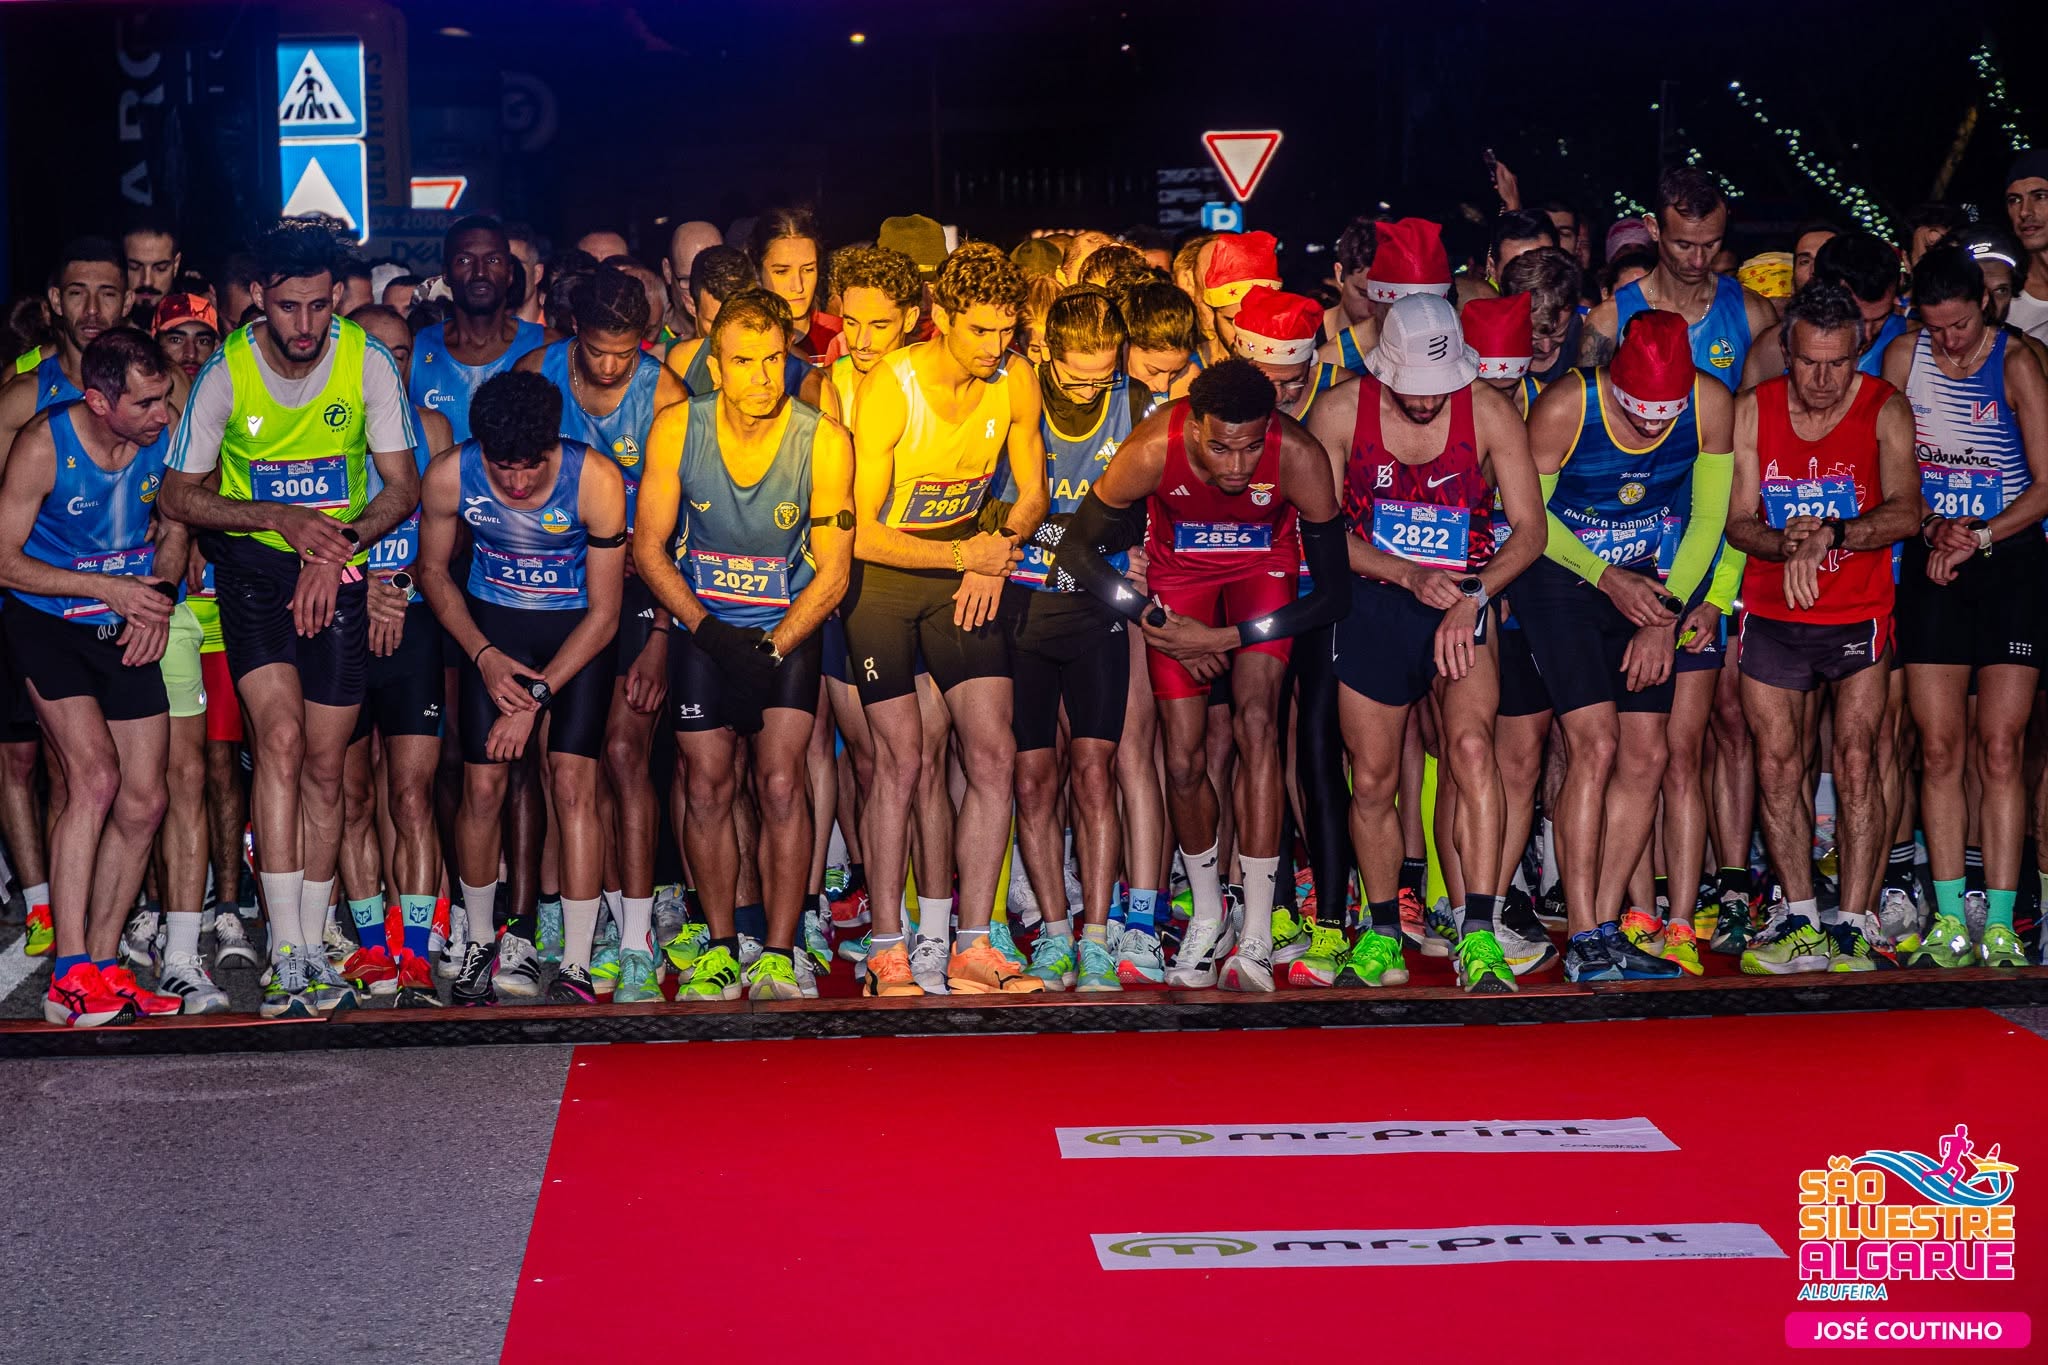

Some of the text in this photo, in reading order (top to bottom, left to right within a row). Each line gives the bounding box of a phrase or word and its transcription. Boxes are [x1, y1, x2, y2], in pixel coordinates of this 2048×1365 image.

[1211, 207, 1238, 231] P
[1917, 444, 1999, 468] Odemira
[256, 464, 281, 472] DELL
[1924, 471, 1943, 480] DELL
[270, 476, 329, 498] 3006
[919, 484, 942, 492] DELL
[1768, 485, 1791, 493] DELL
[76, 500, 100, 509] TRAVEL
[920, 495, 971, 517] 2981
[1381, 503, 1406, 513] DELL
[1784, 501, 1840, 520] 2826
[1933, 492, 1985, 516] 2816
[473, 514, 501, 524] TRAVEL
[1194, 532, 1252, 544] 2856
[1392, 523, 1450, 550] 2822
[1582, 530, 1607, 542] DELL
[367, 538, 409, 562] 170
[487, 551, 511, 561] DELL
[698, 553, 721, 563] DELL
[1599, 539, 1647, 565] 2928
[77, 560, 98, 570] DELL
[501, 566, 558, 584] 2160
[712, 569, 769, 592] 2027
[1228, 1125, 1592, 1141] mr.print
[1273, 1231, 1688, 1252] mr.print
